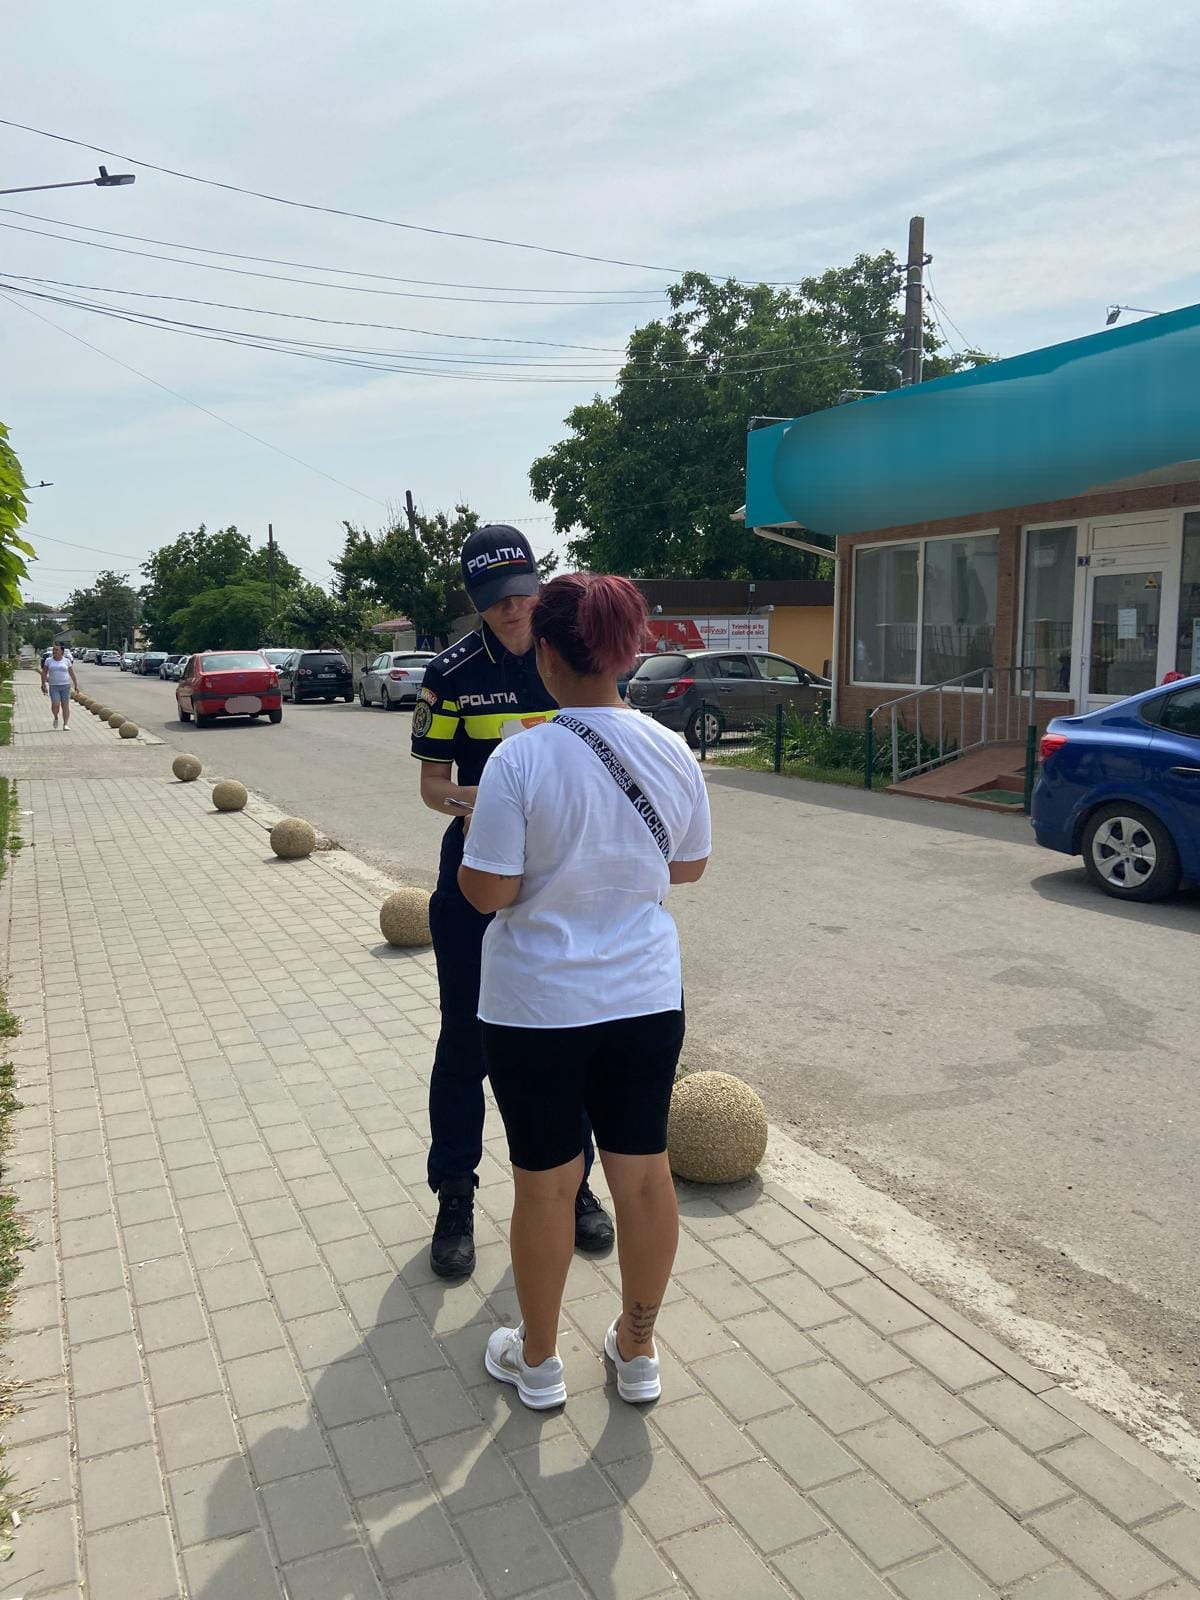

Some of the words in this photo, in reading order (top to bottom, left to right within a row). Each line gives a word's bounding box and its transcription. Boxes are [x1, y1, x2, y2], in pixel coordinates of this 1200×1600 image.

[467, 547, 526, 573] POLITIA
[459, 692, 518, 708] POLITIA
[555, 715, 588, 736] 1980
